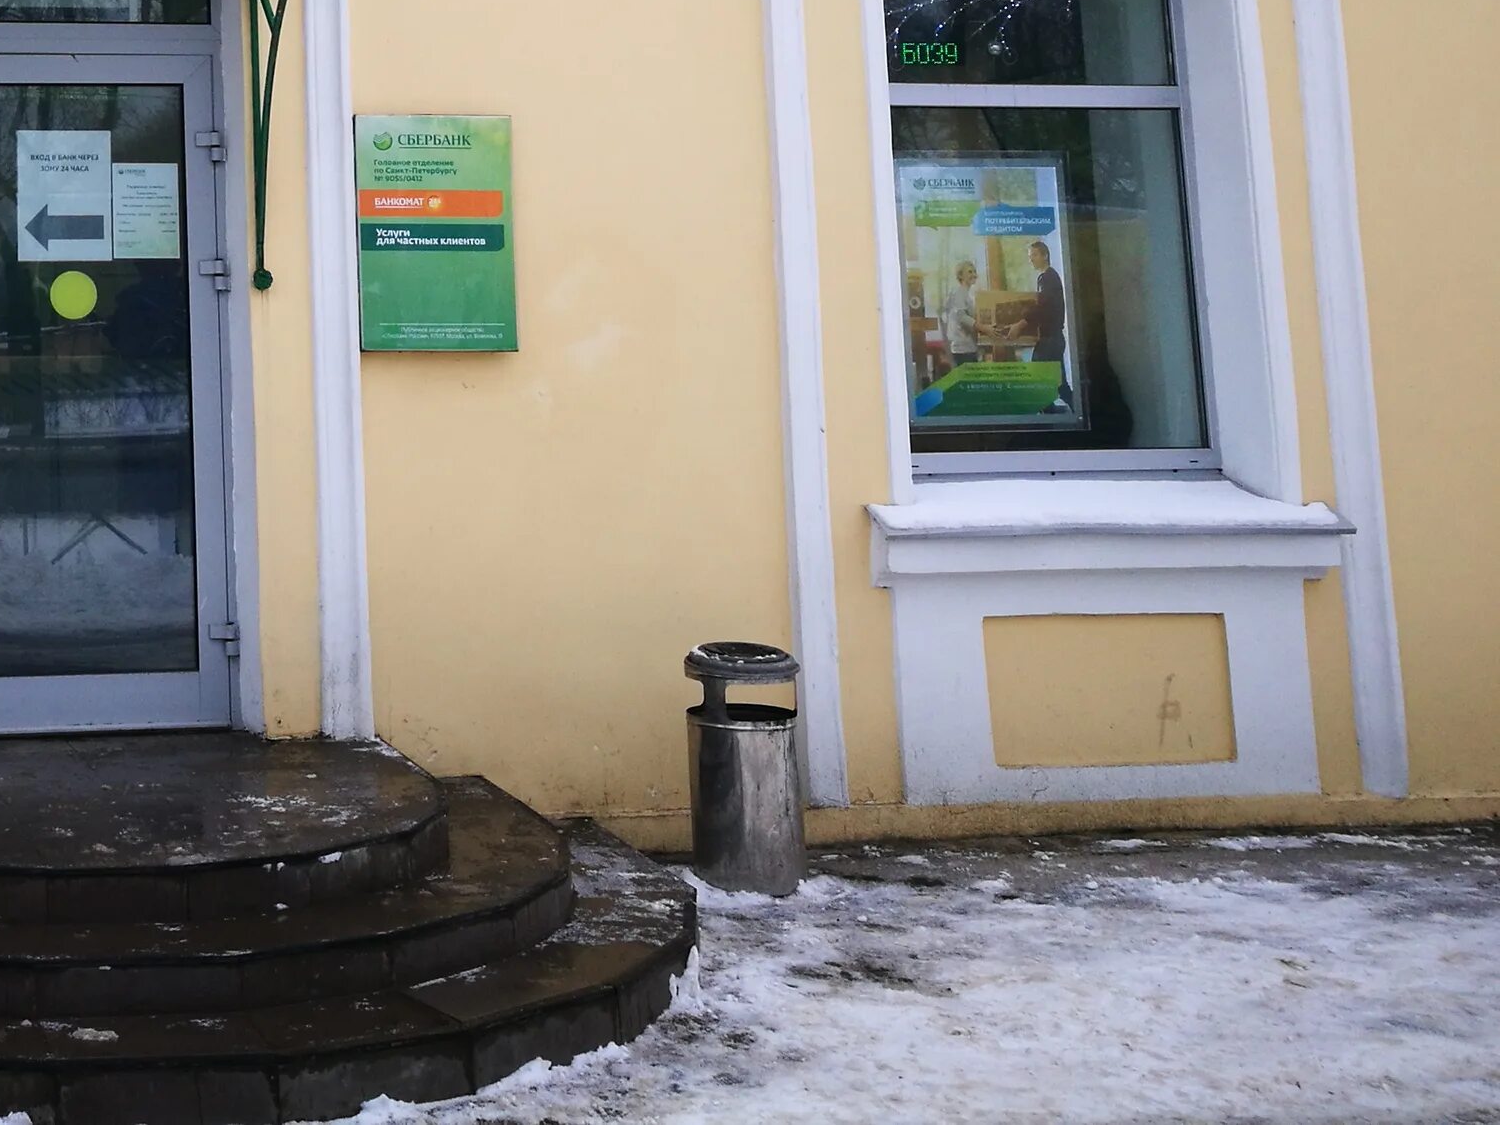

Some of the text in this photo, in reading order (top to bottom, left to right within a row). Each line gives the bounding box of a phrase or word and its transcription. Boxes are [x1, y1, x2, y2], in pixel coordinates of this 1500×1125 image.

[398, 133, 471, 146] СБЕРБАНК
[30, 154, 50, 162] ВХОД
[374, 165, 457, 176] по Санкт-Петербургу
[374, 197, 424, 206] БАНКОМАТ
[376, 228, 410, 239] Услуги
[376, 237, 486, 246] для частных клиентов
